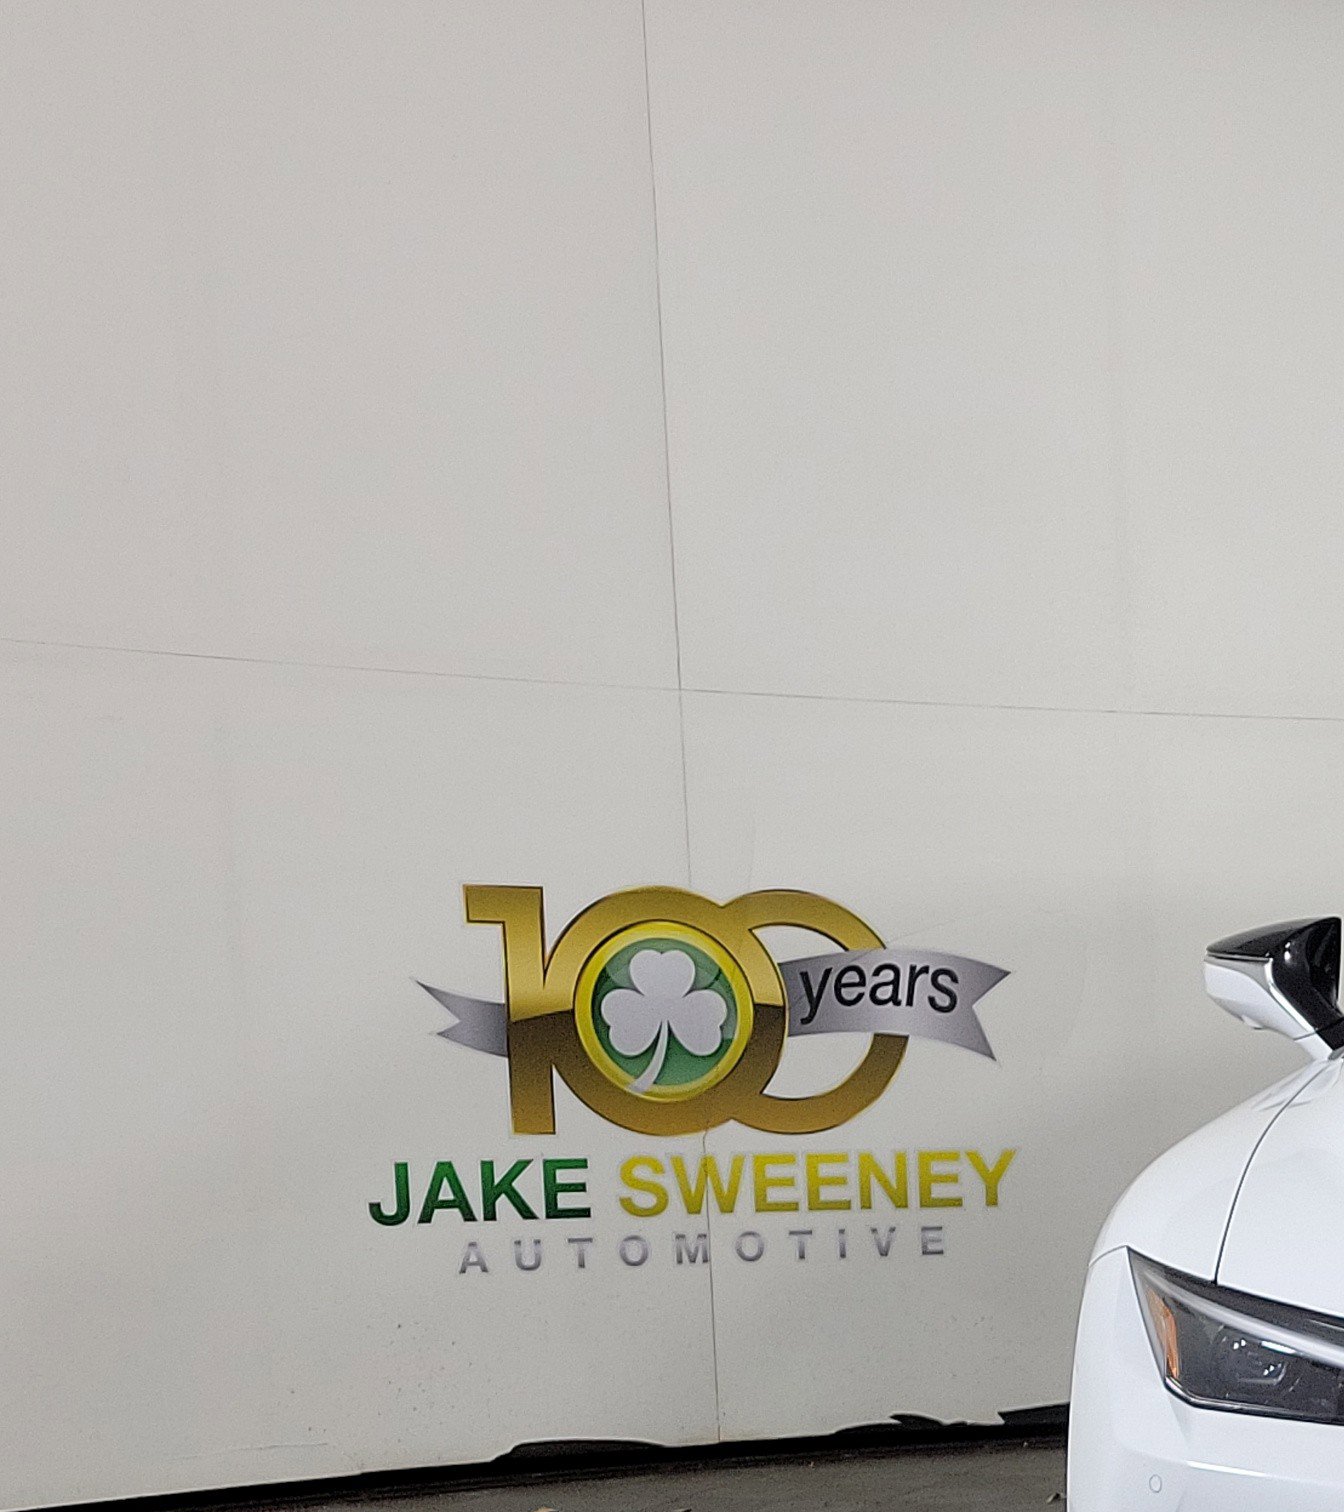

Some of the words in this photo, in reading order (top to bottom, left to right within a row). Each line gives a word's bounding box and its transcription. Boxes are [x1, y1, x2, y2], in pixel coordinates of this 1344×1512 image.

[462, 884, 910, 1136] 100
[800, 961, 959, 1024] years
[368, 1157, 592, 1227] JAKE
[618, 1148, 1018, 1219] SWEENEY
[458, 1225, 946, 1275] AUTOMOTIVE
